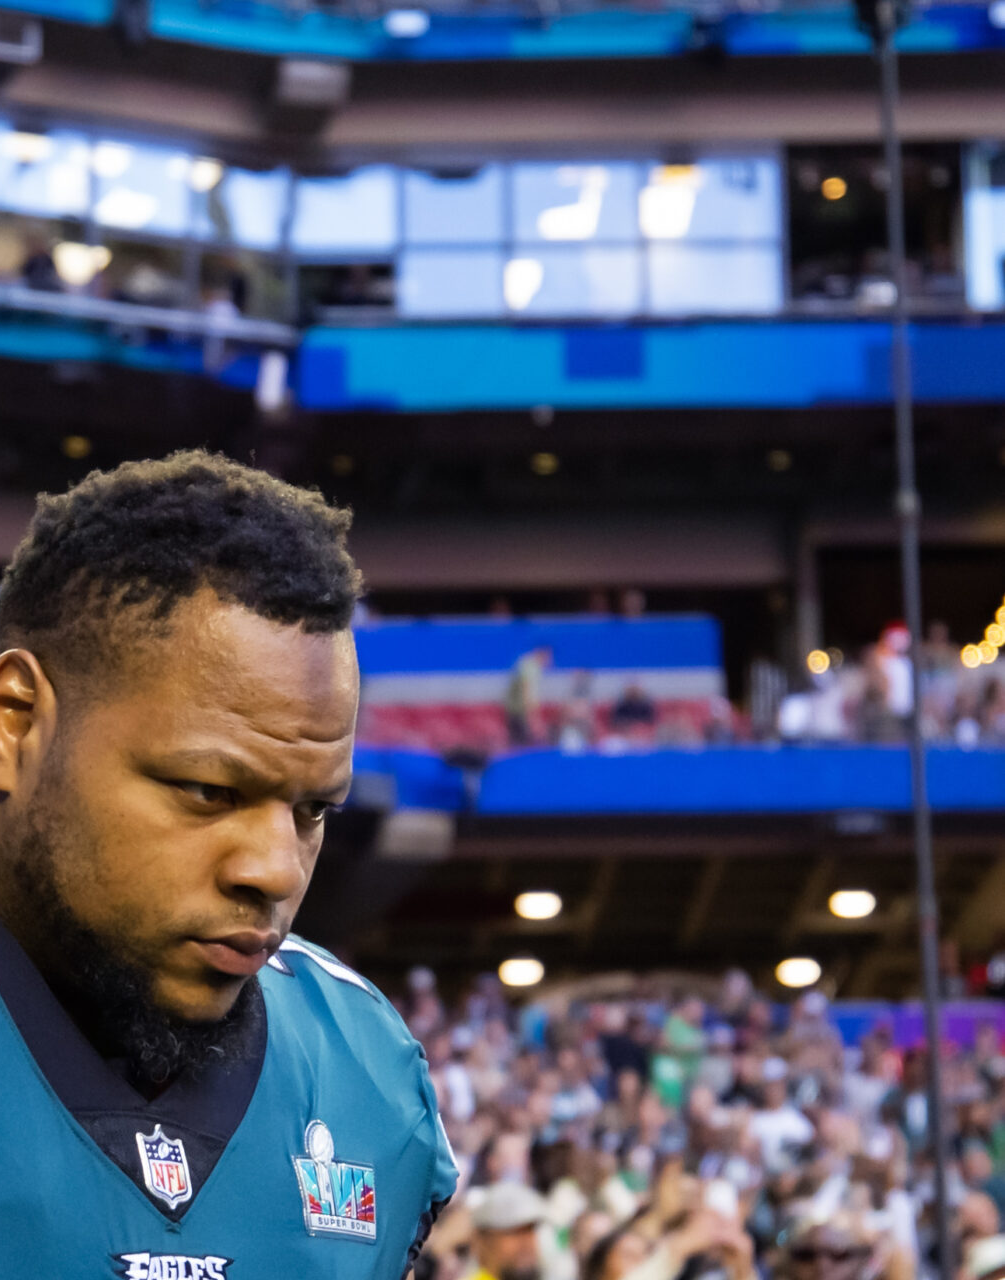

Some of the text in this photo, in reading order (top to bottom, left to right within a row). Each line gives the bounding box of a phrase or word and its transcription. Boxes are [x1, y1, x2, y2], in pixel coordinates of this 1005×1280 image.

[152, 1162, 186, 1194] NFL
[317, 1216, 371, 1233] SUPER BOWL
